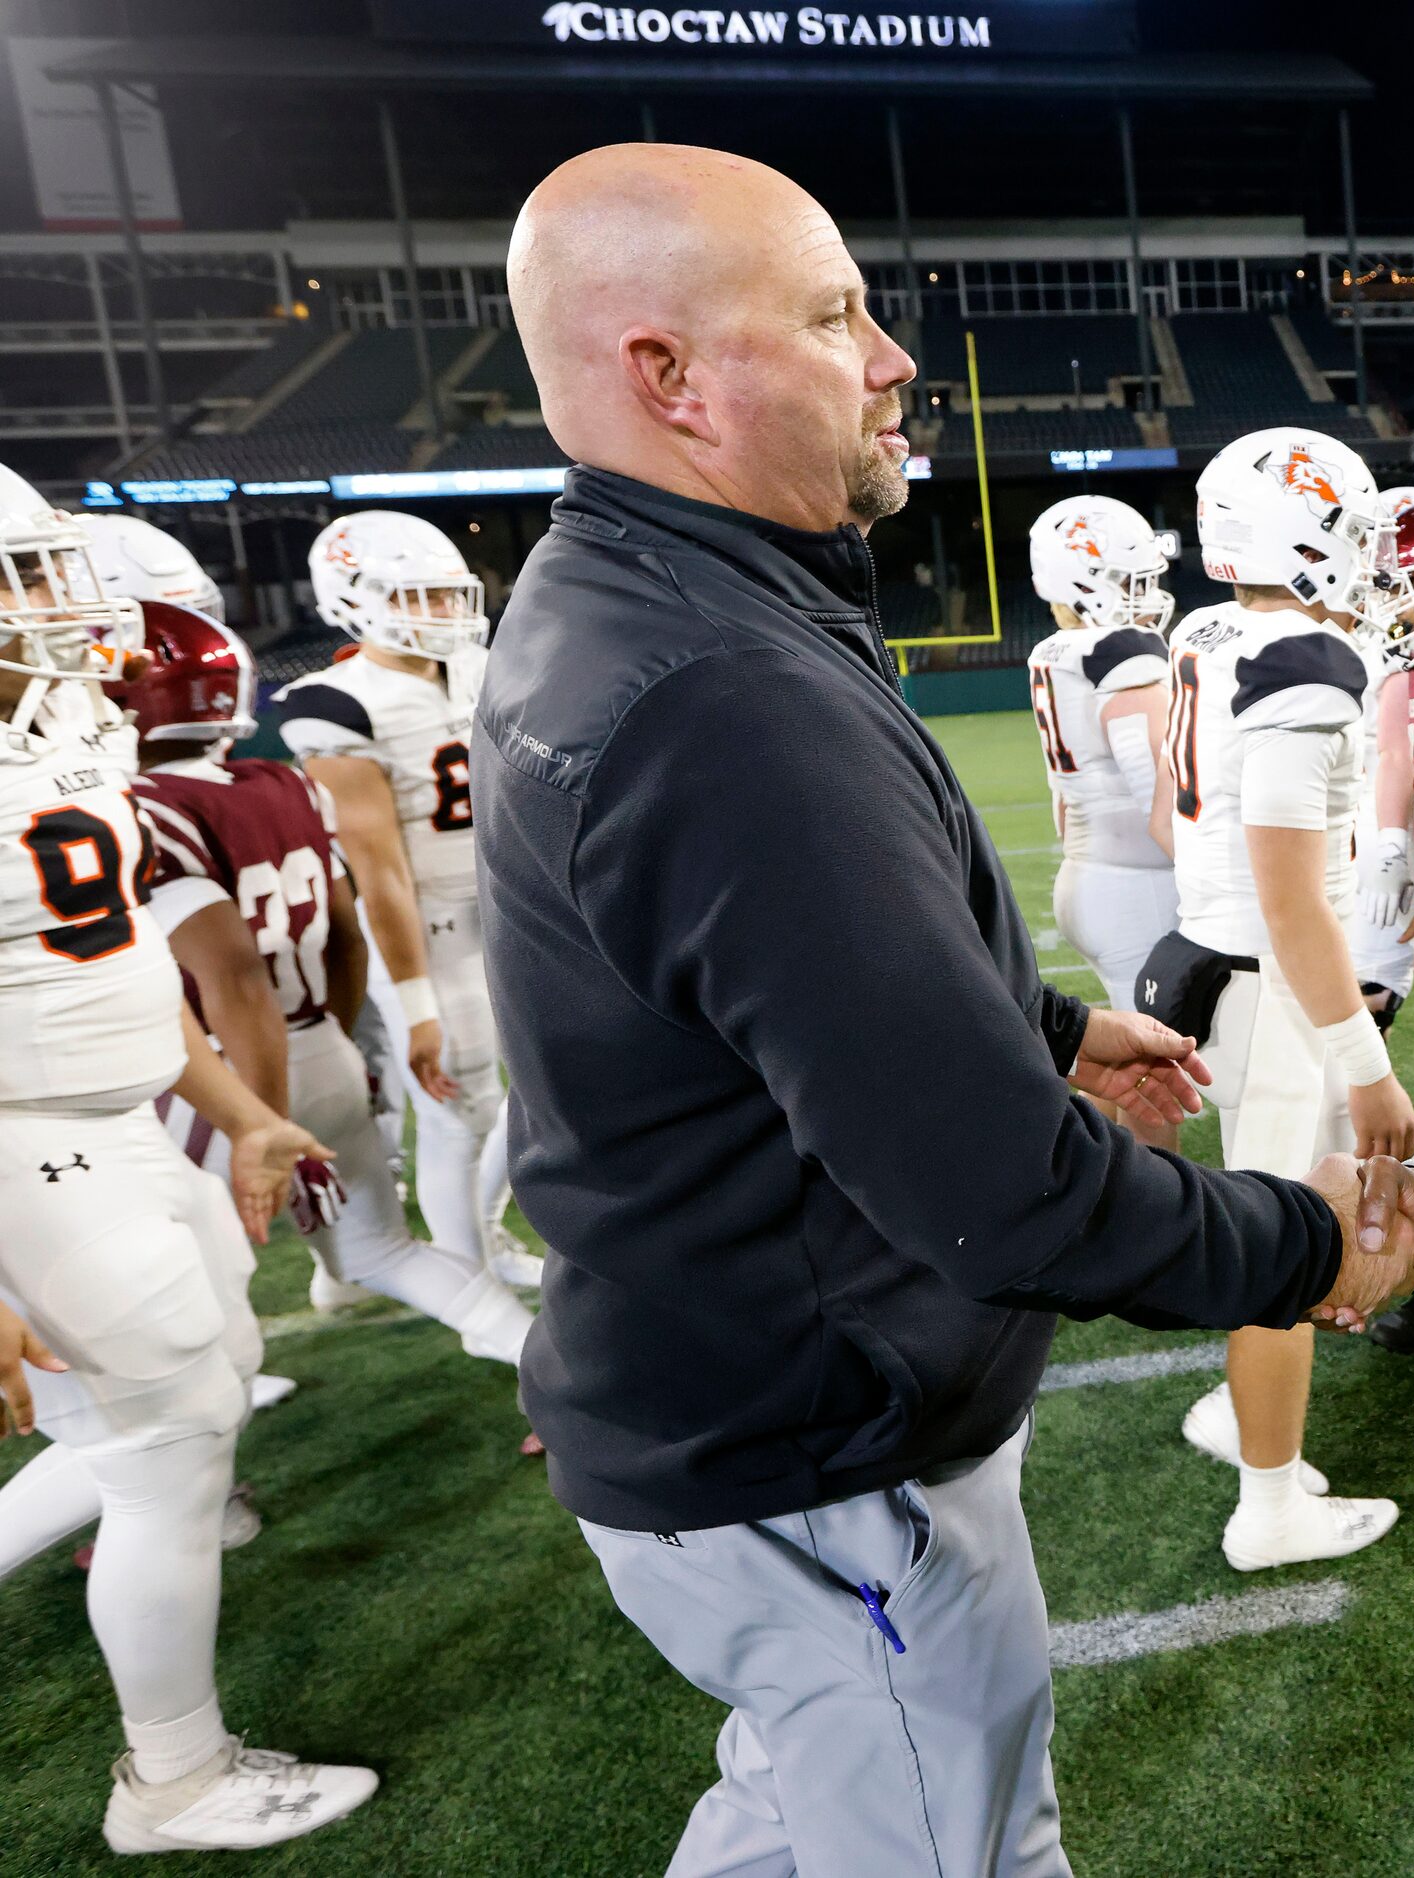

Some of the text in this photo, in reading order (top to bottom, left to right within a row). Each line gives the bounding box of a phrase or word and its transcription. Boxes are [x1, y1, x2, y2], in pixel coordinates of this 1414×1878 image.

[569, 2, 991, 47] CHOCTAW STADIUM
[520, 733, 573, 768] ARMOUR
